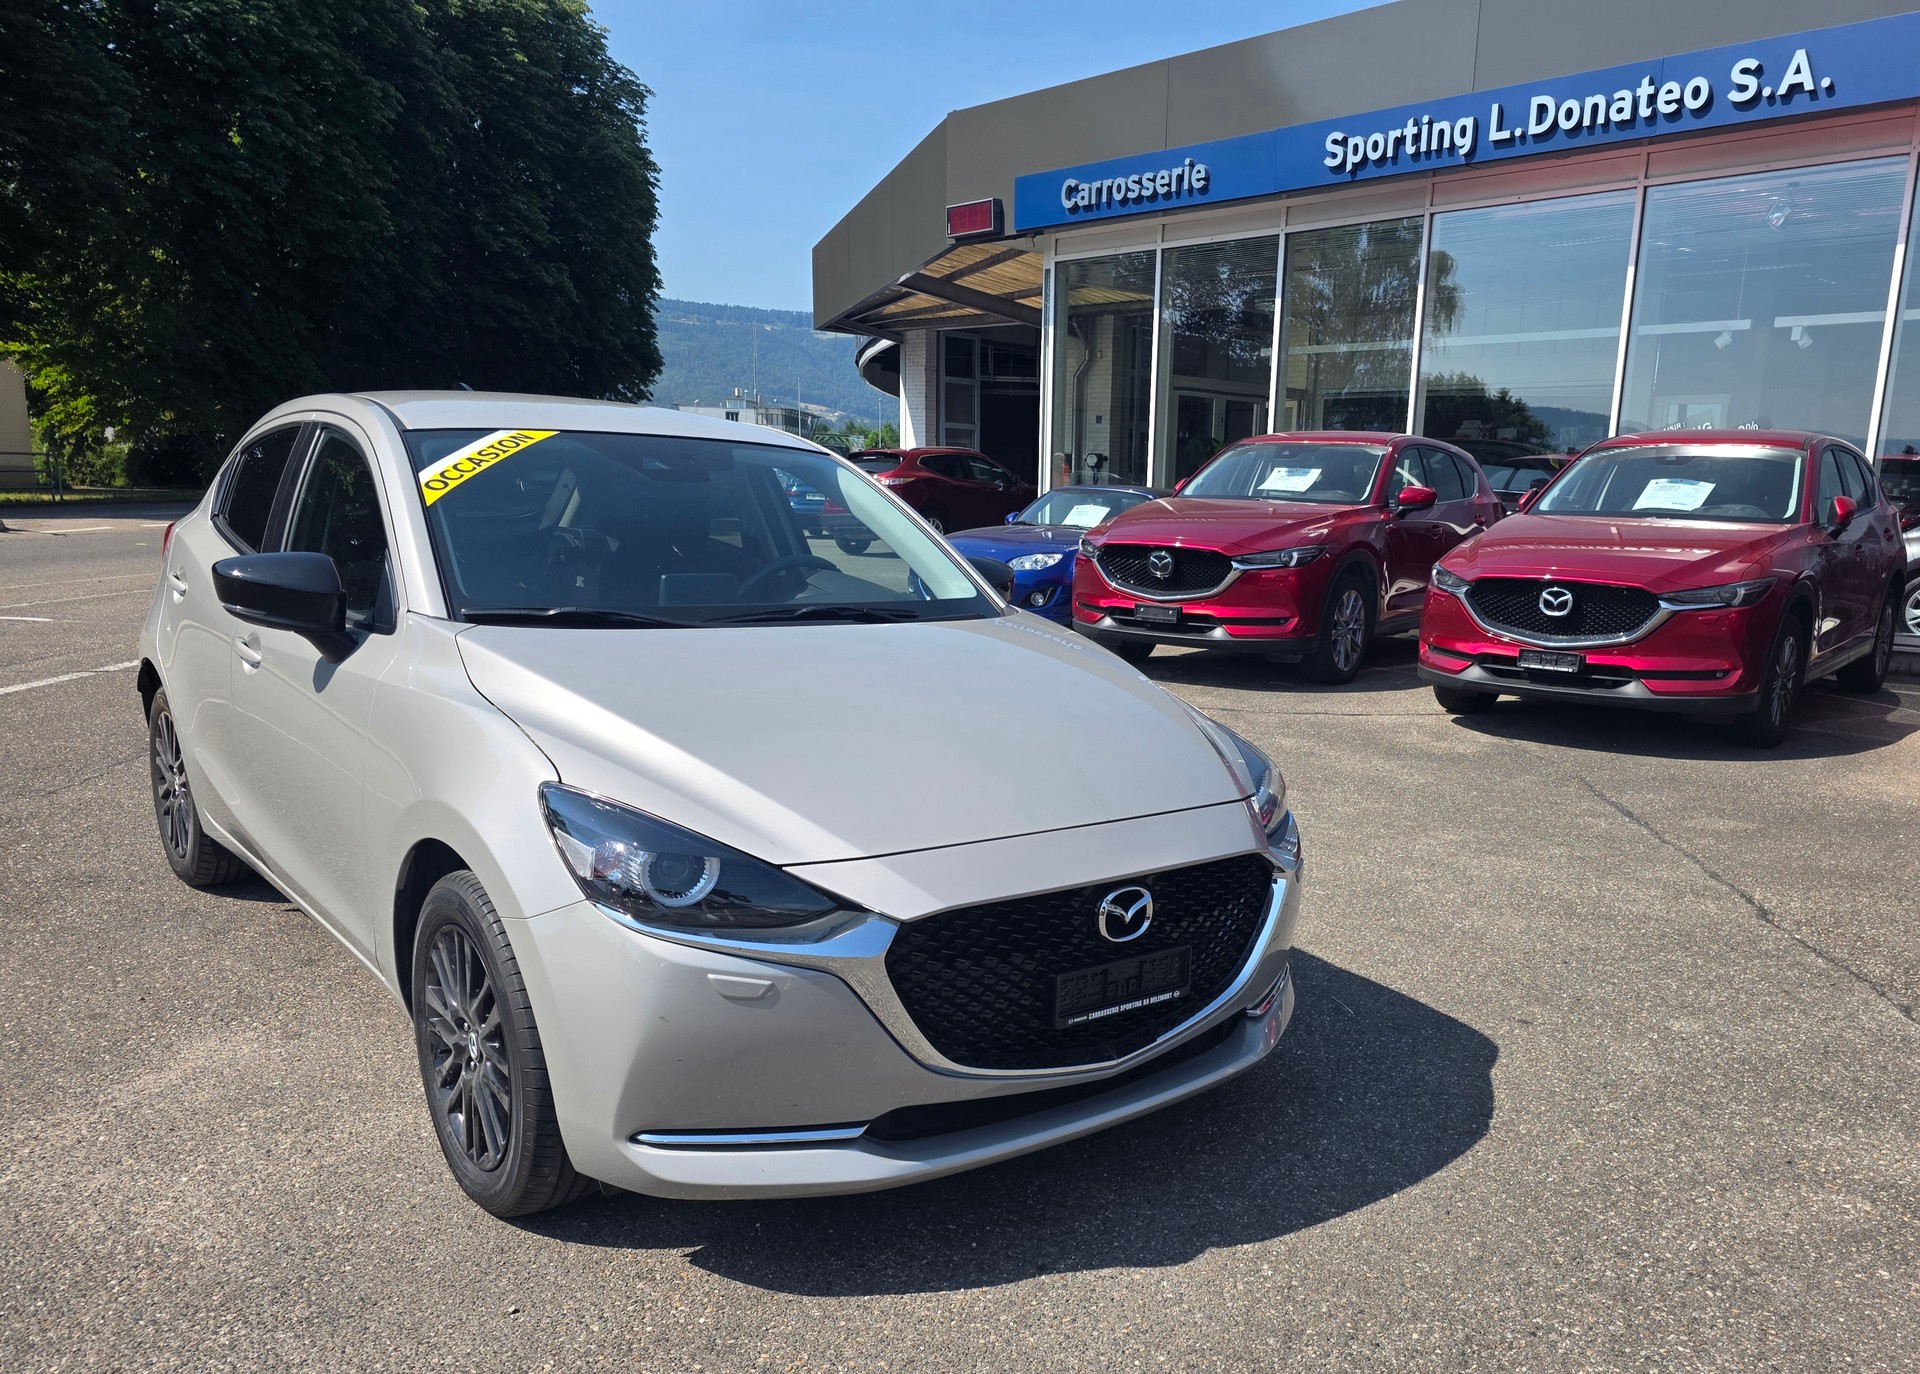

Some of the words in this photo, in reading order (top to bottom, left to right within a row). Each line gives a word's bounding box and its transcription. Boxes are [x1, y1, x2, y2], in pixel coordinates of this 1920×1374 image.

[1323, 114, 1474, 173] Sporting
[1727, 48, 1831, 102] S.A.
[1060, 157, 1207, 209] Carrosserie
[424, 432, 535, 491] OCCASION
[1088, 1005, 1120, 1020] CARROSSERIE
[1120, 1000, 1142, 1011] SPORTING
[1143, 998, 1150, 1006] SA
